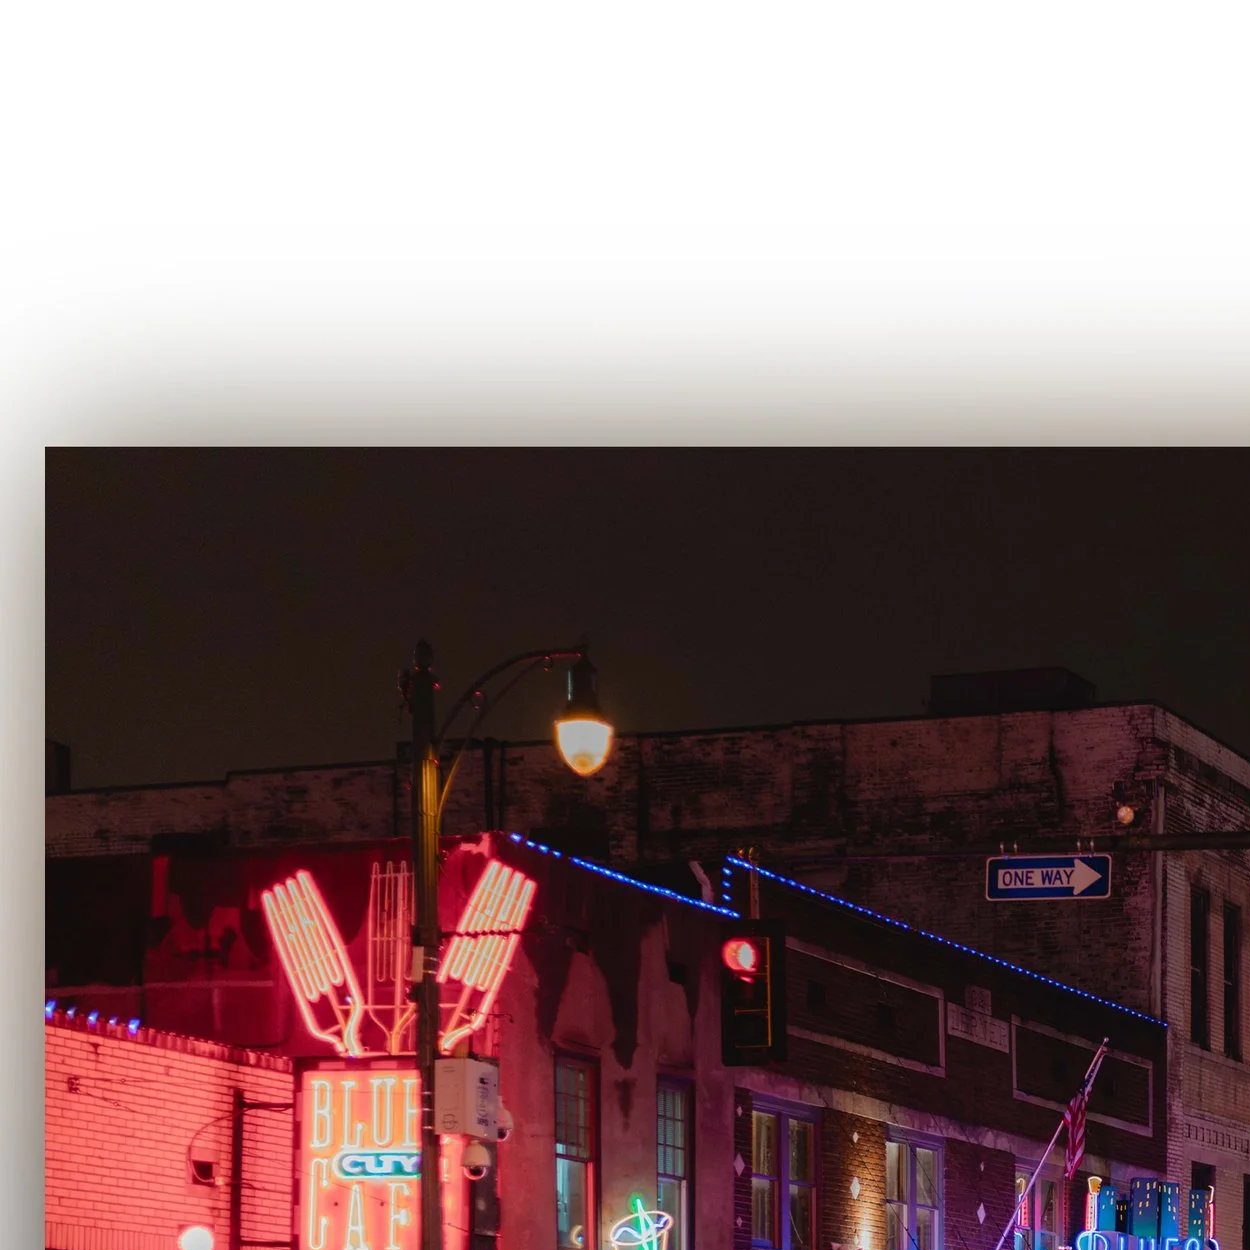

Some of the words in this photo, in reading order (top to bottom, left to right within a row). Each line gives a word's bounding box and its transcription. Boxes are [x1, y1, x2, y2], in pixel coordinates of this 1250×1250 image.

[1002, 870, 1035, 887] ONE
[1041, 869, 1075, 885] WAY
[310, 1077, 418, 1149] BLUE
